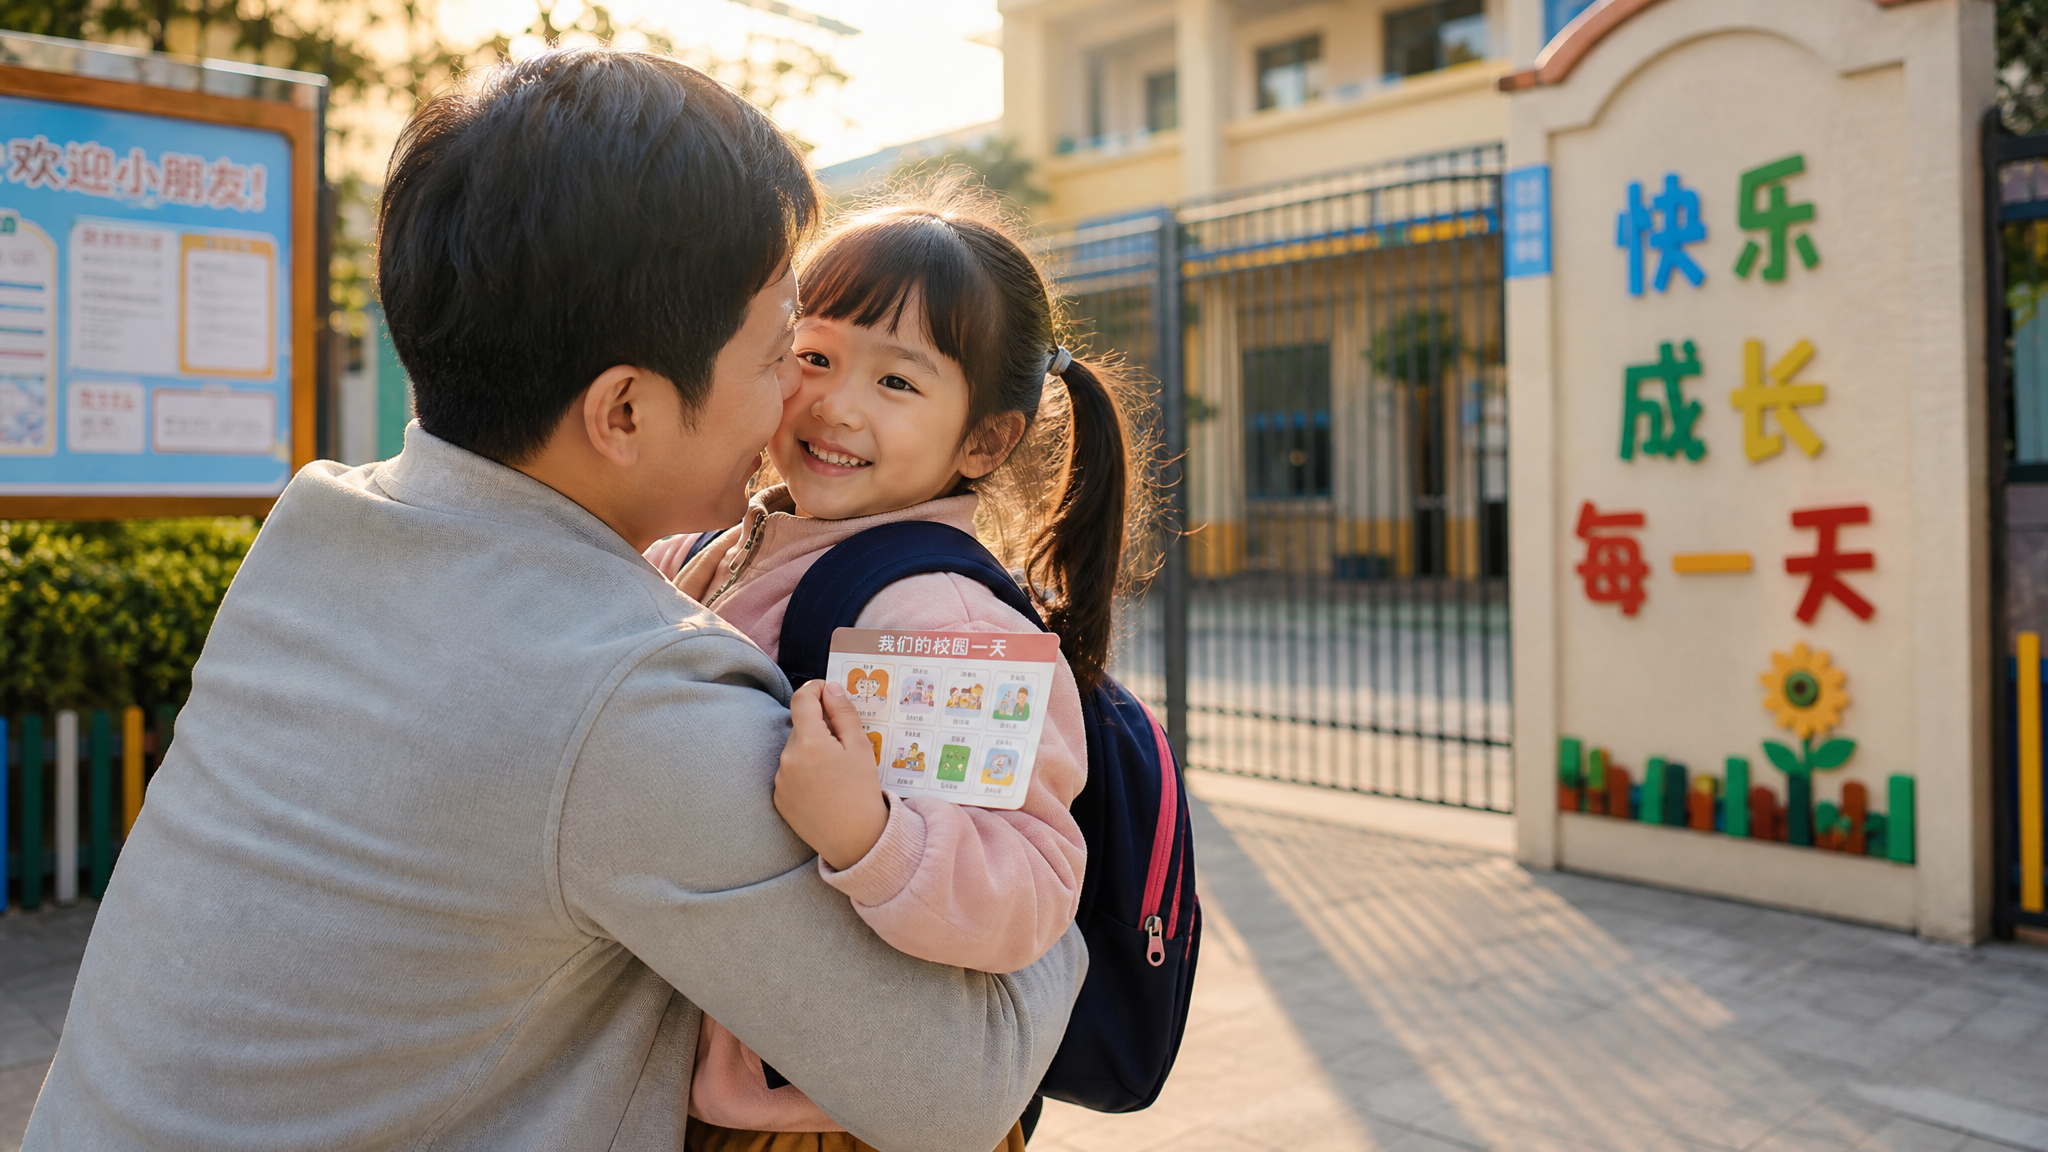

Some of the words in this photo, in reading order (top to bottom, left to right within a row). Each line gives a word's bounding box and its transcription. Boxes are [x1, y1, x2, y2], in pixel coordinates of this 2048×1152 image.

[1616, 154, 1820, 297] 快乐
[1618, 339, 1826, 463] 成长
[1576, 500, 1876, 626] 每一天
